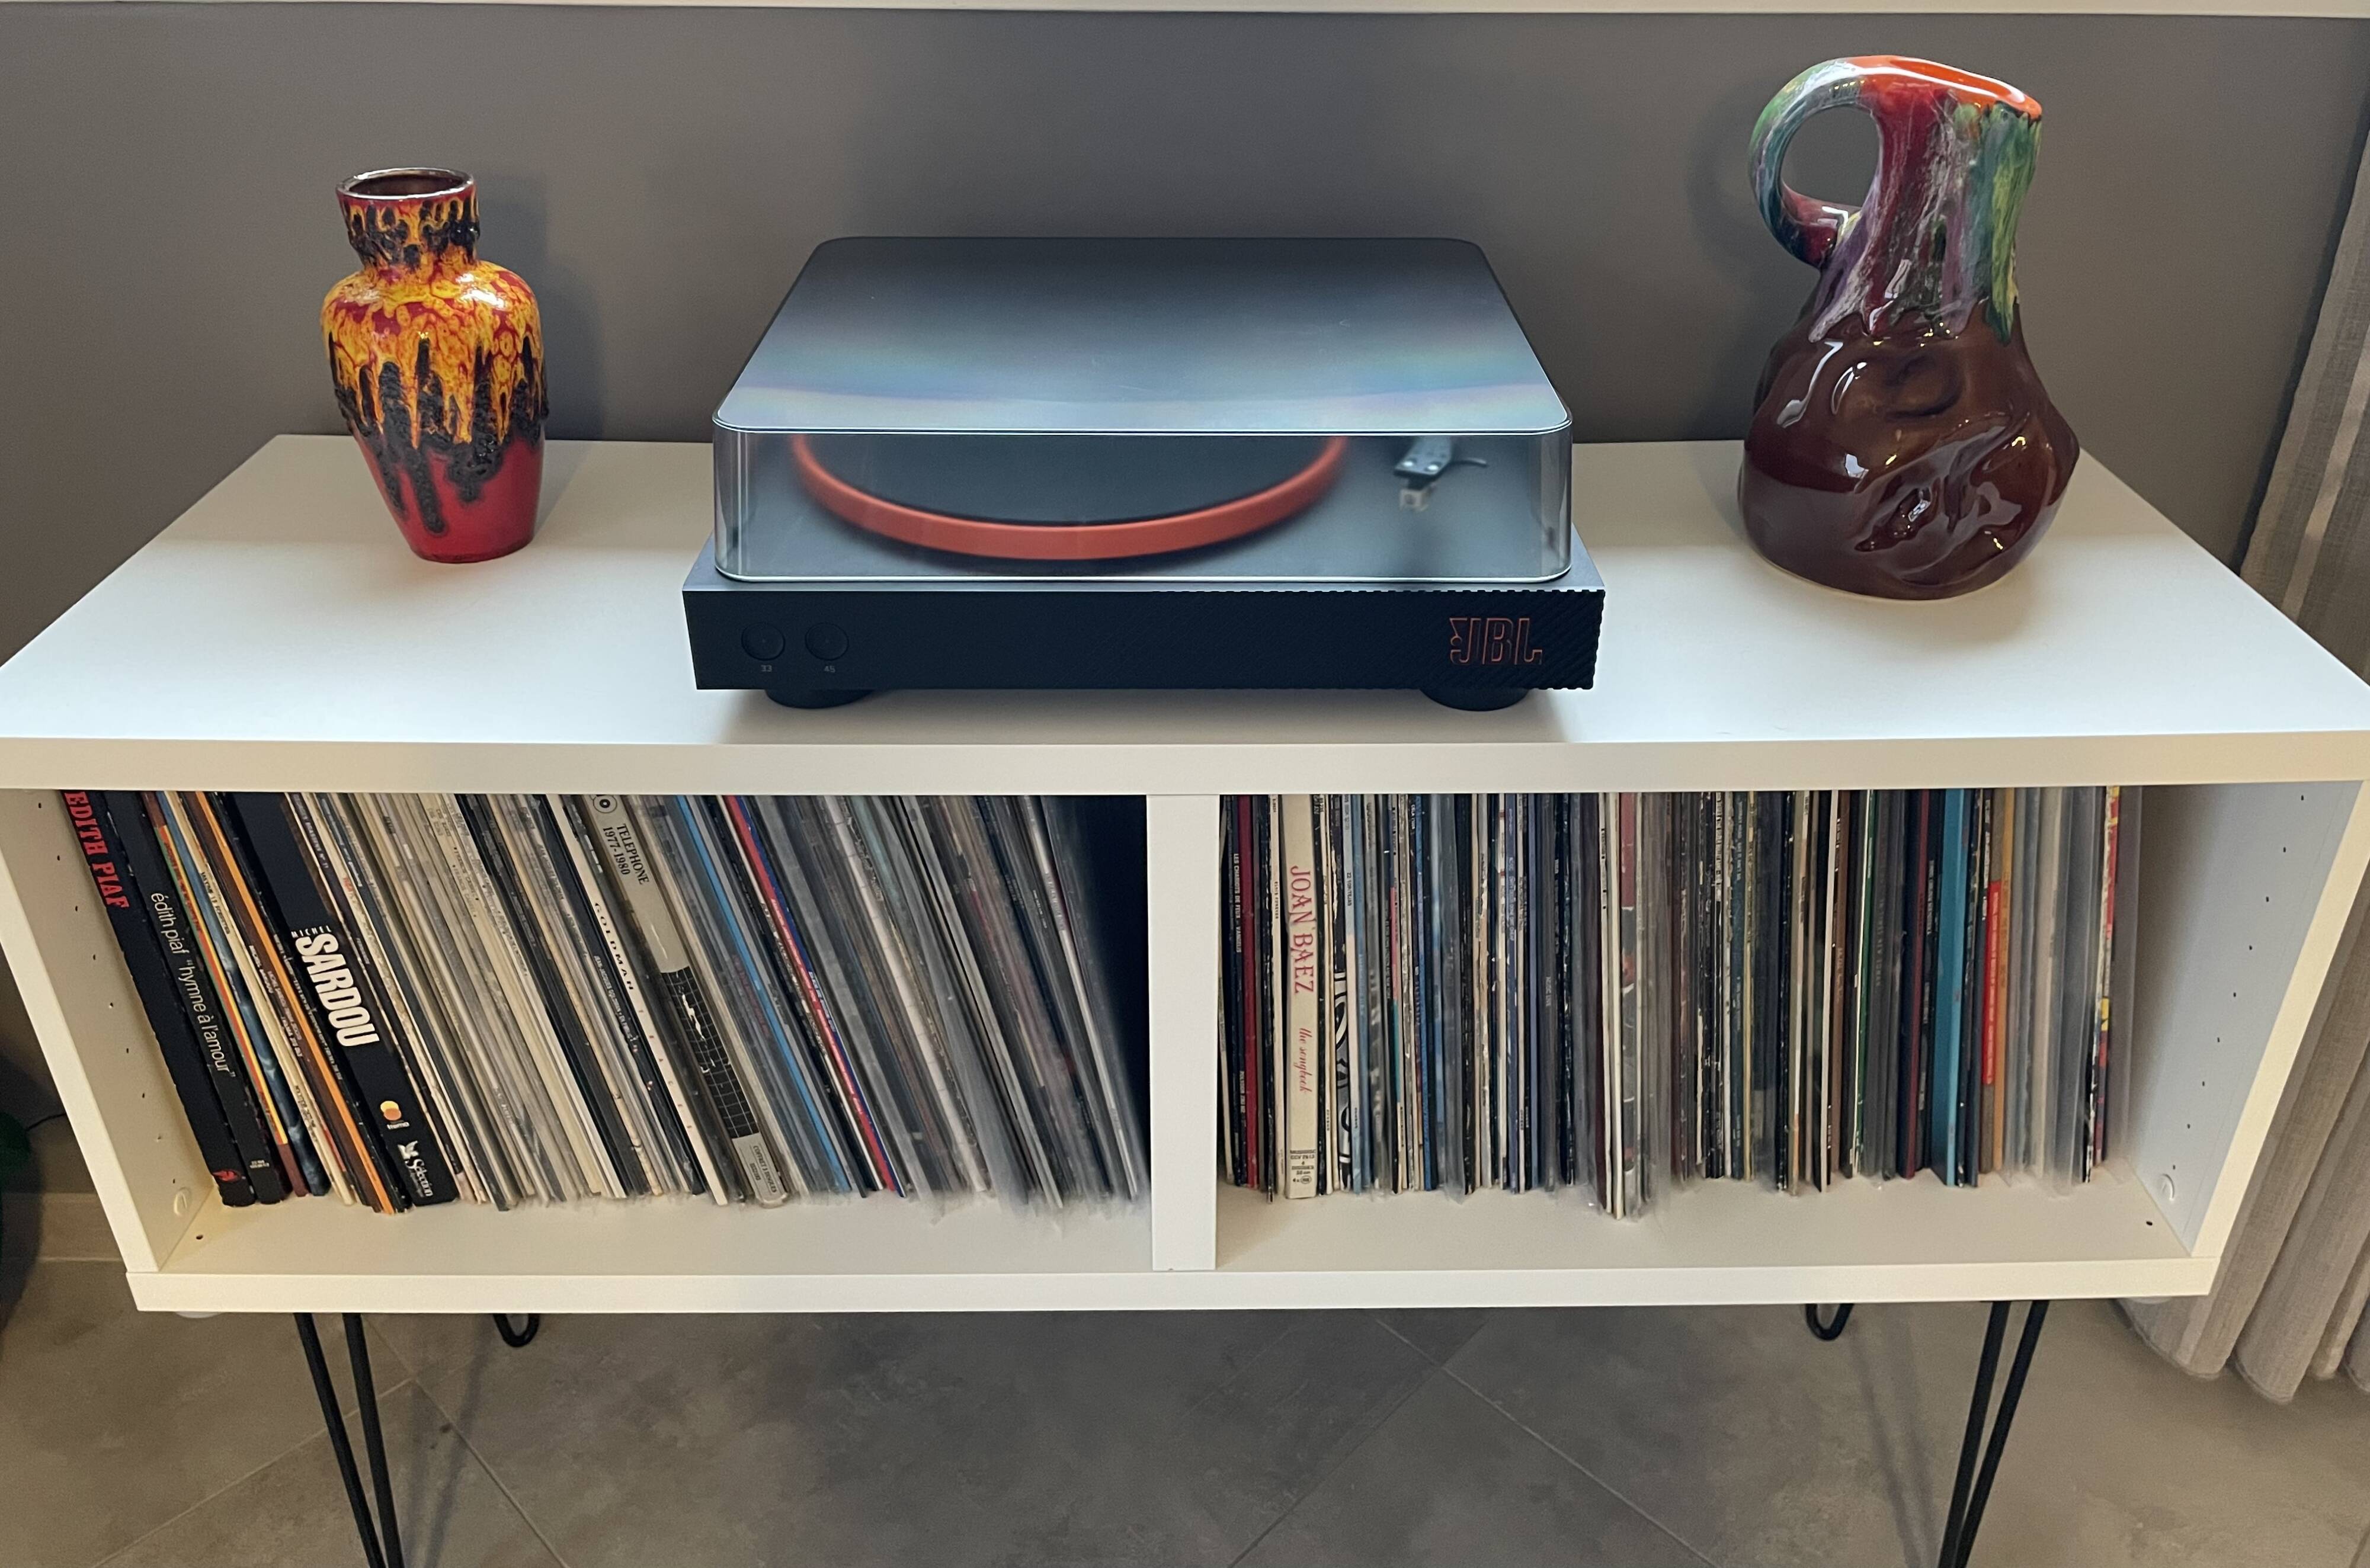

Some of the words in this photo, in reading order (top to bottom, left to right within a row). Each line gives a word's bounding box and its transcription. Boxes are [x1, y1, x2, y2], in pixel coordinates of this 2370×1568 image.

[1449, 618, 1542, 665] JBL
[64, 791, 108, 855] EDITH
[92, 862, 130, 908] PIAF
[603, 827, 630, 875] 1977-1980
[616, 823, 649, 884] TELEPHONE
[151, 893, 177, 928] édith
[1288, 865, 1317, 925] JOAN
[161, 928, 190, 954] piaf
[291, 925, 332, 938] MICHEL
[595, 902, 634, 990] GOLDMAN
[1289, 933, 1314, 994] BAEZ
[295, 933, 380, 1047] SARDOU
[197, 1014, 213, 1024] à
[1299, 1027, 1313, 1042] the
[1293, 1047, 1313, 1094] songbook
